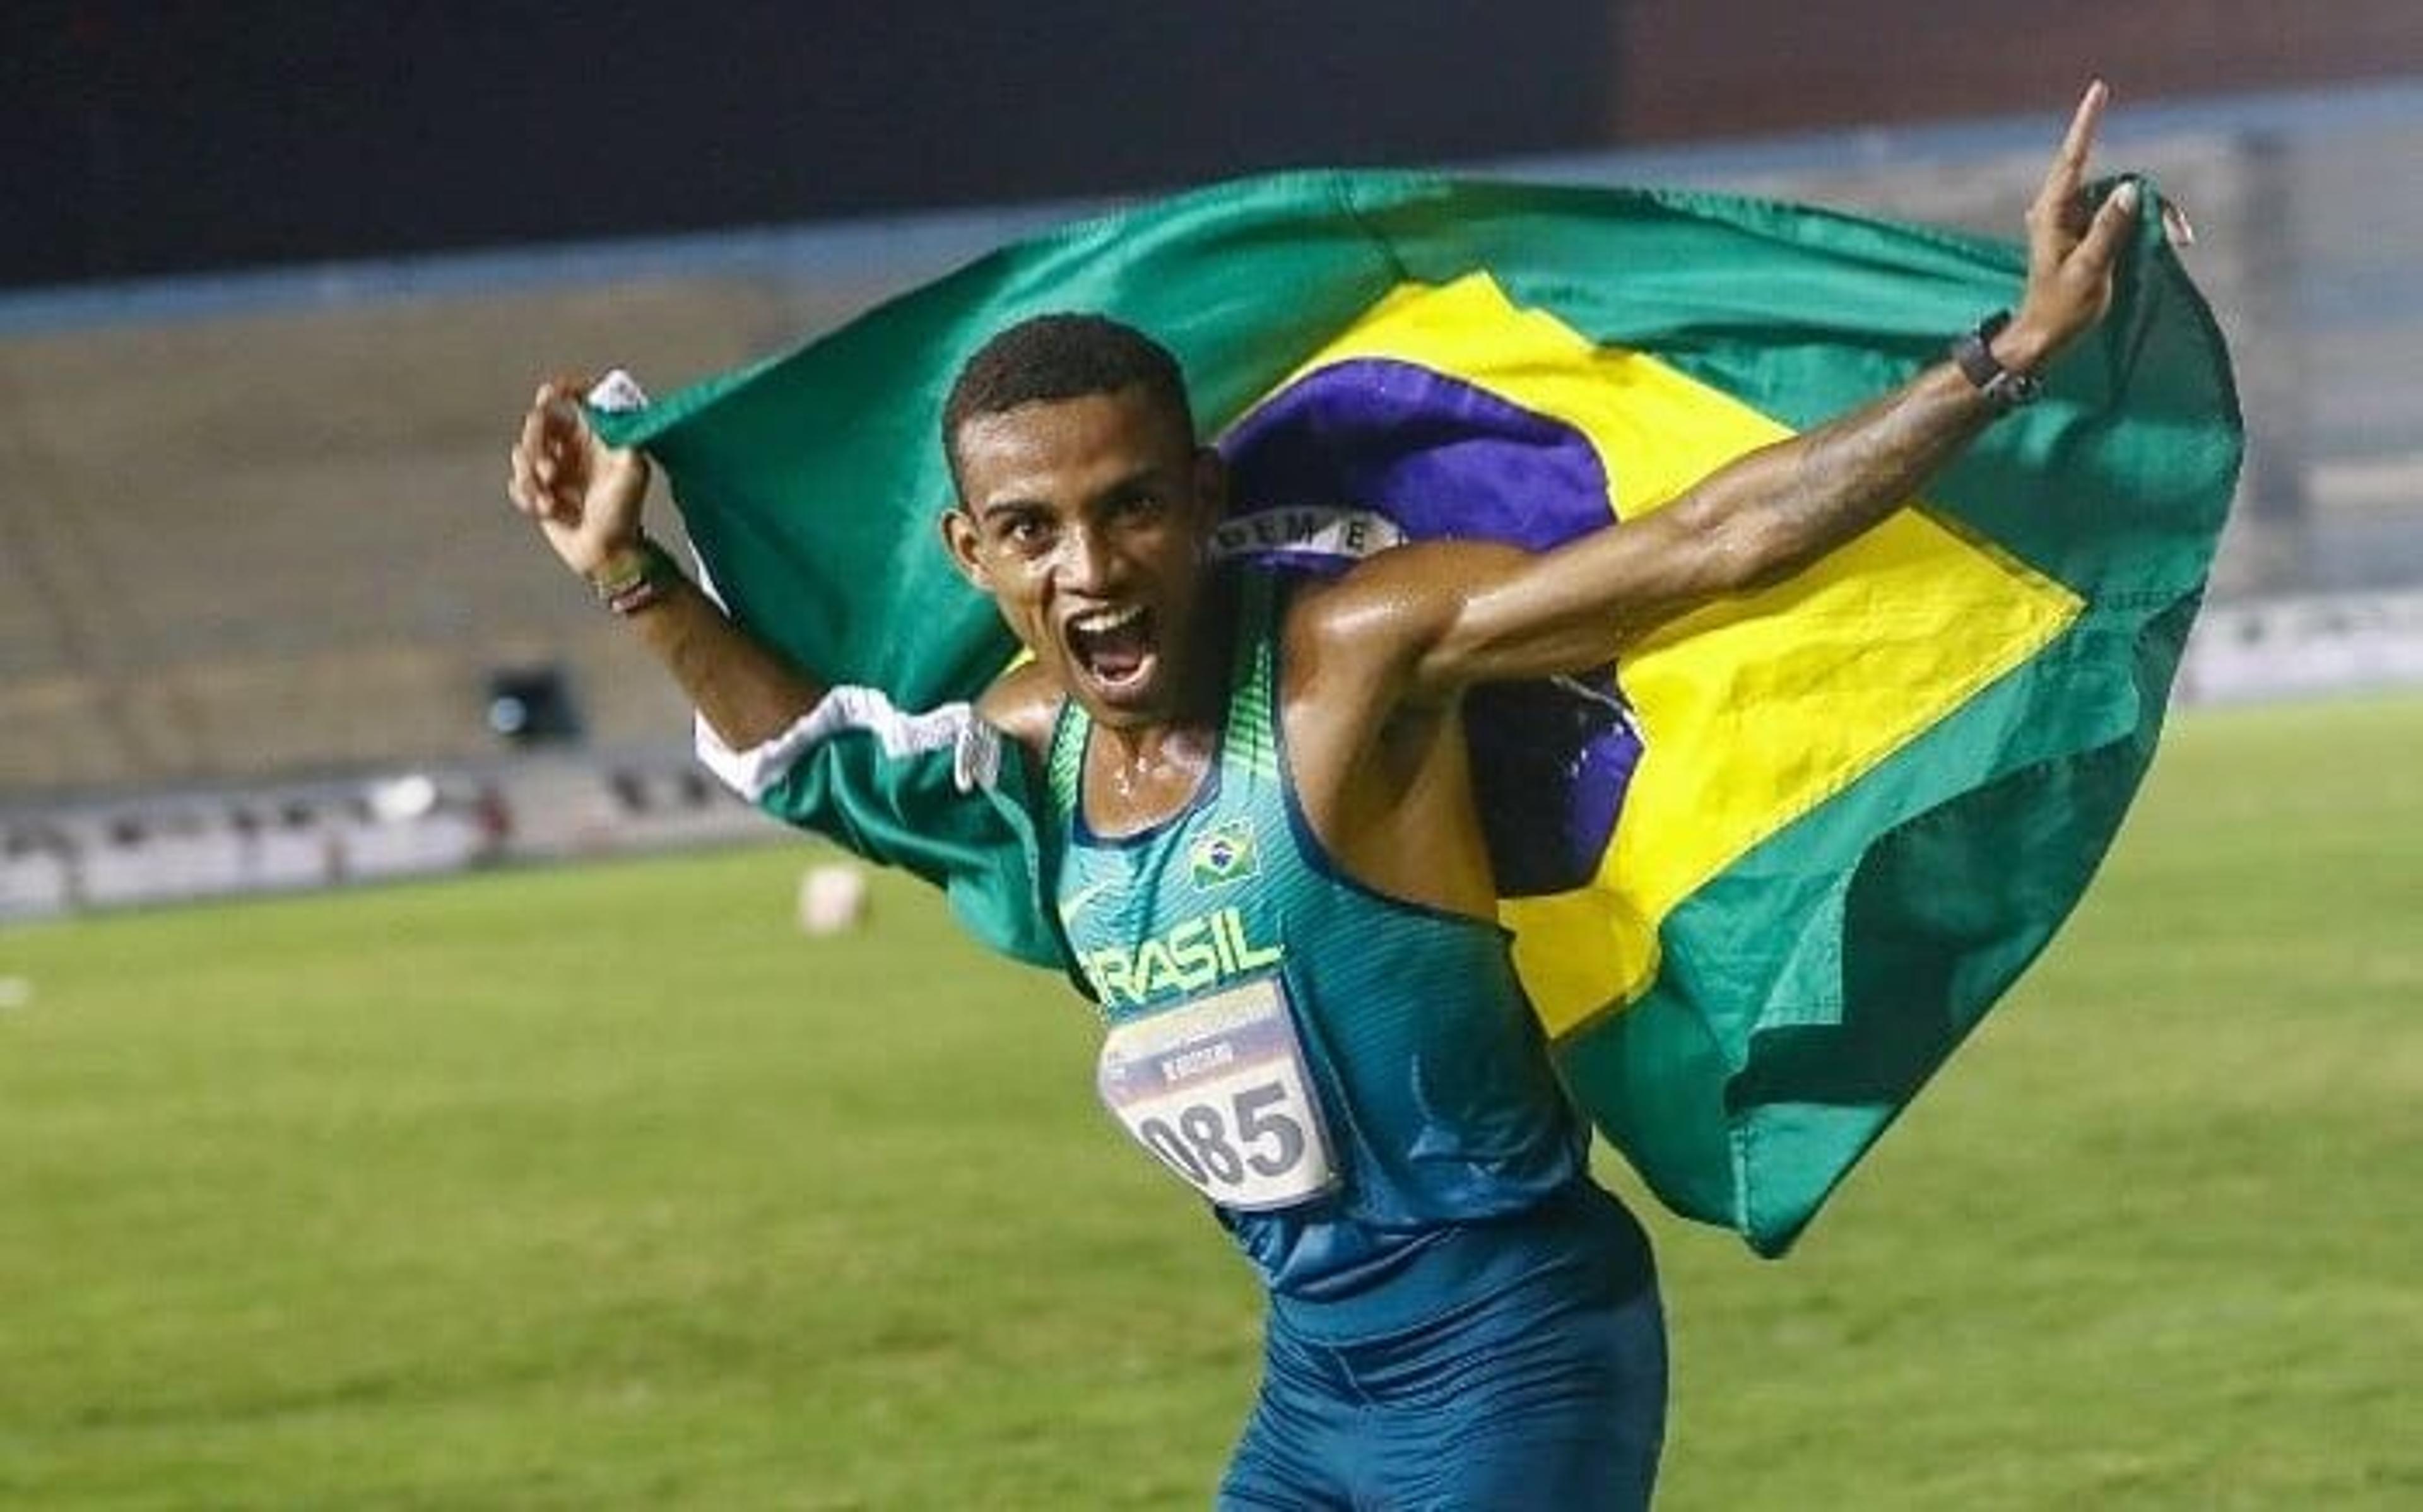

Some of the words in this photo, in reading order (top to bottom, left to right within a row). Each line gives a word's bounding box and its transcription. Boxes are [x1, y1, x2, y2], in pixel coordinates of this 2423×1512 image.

[1347, 520, 1365, 551] E
[1078, 906, 1285, 1005] RASIL
[1140, 1081, 1305, 1186] 085
